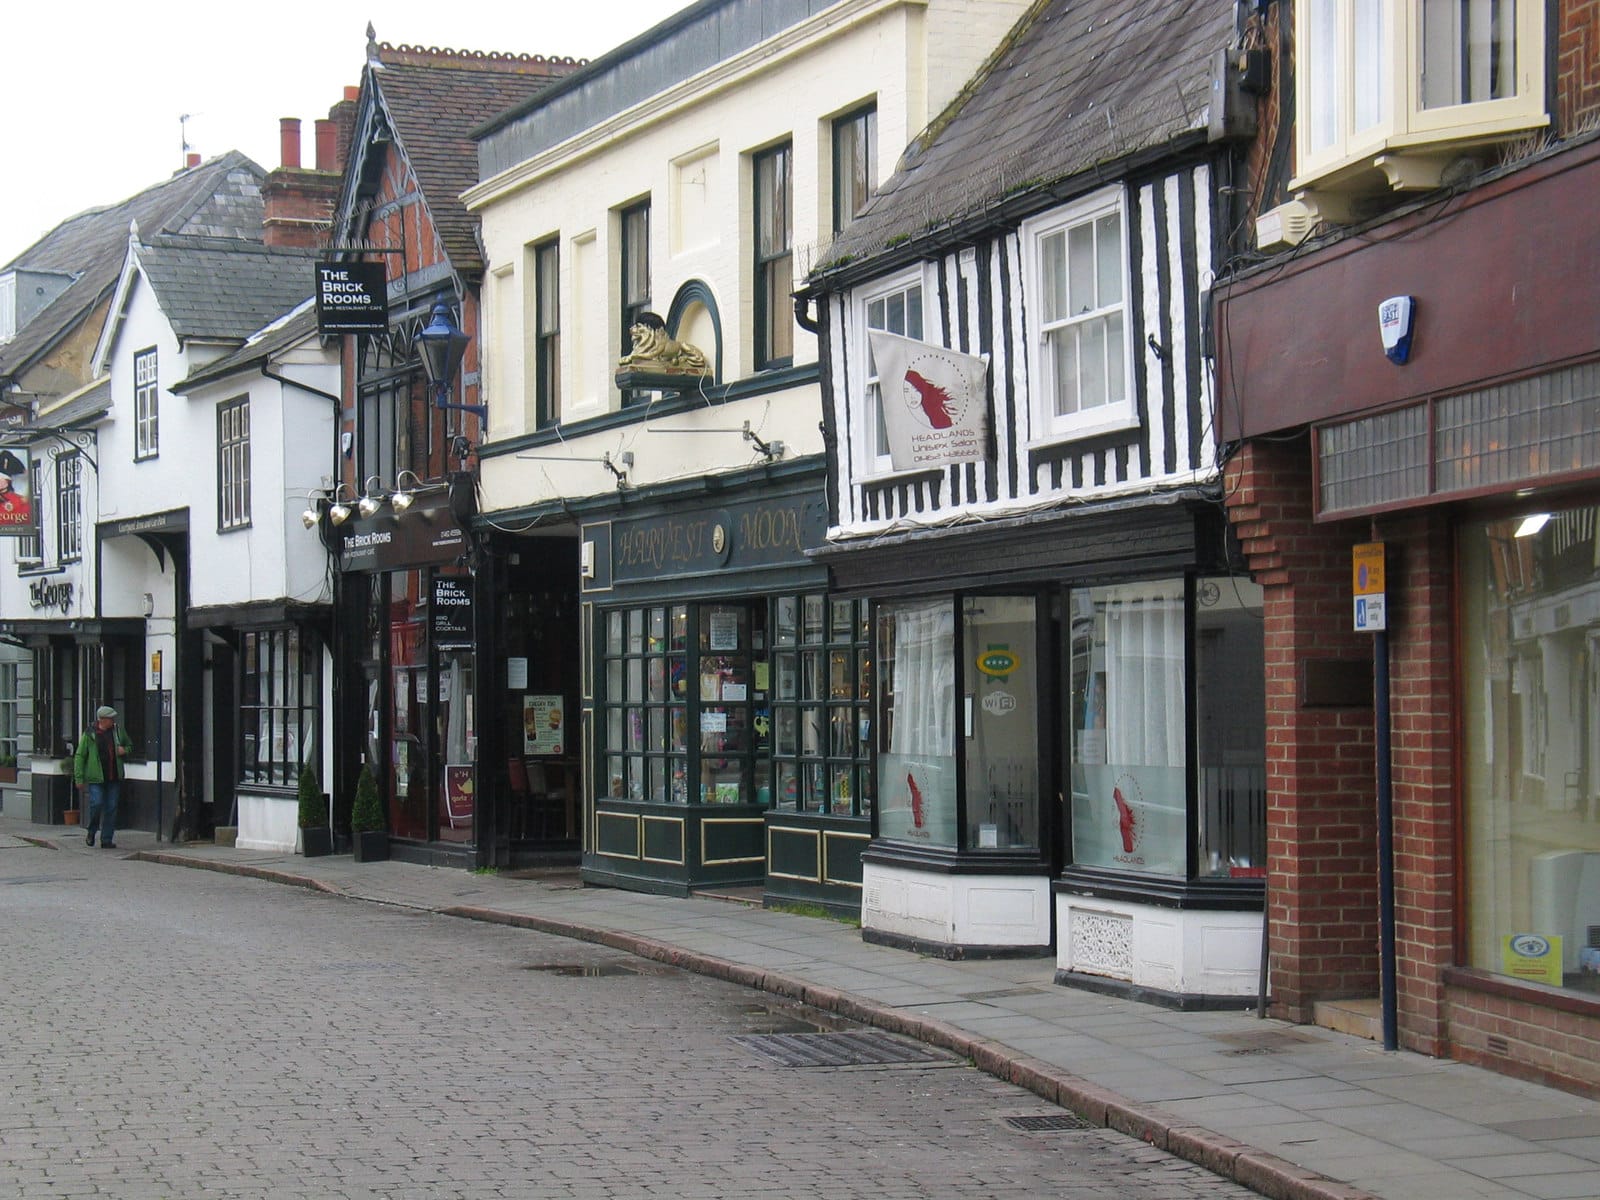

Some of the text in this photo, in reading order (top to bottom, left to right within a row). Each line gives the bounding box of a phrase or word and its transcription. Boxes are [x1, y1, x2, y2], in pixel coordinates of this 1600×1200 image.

[321, 269, 349, 281] THE
[322, 281, 364, 292] BRICK
[323, 293, 372, 304] ROOMS
[911, 429, 975, 442] HEADLANDS
[912, 439, 978, 452] Unisex Salon
[344, 531, 392, 549] THE BRICK ROOMS
[618, 502, 806, 570] HARVEST MOON
[436, 581, 456, 589] THE
[40, 576, 74, 615] George
[436, 589, 466, 597] BRICK
[436, 598, 471, 606] ROOMS
